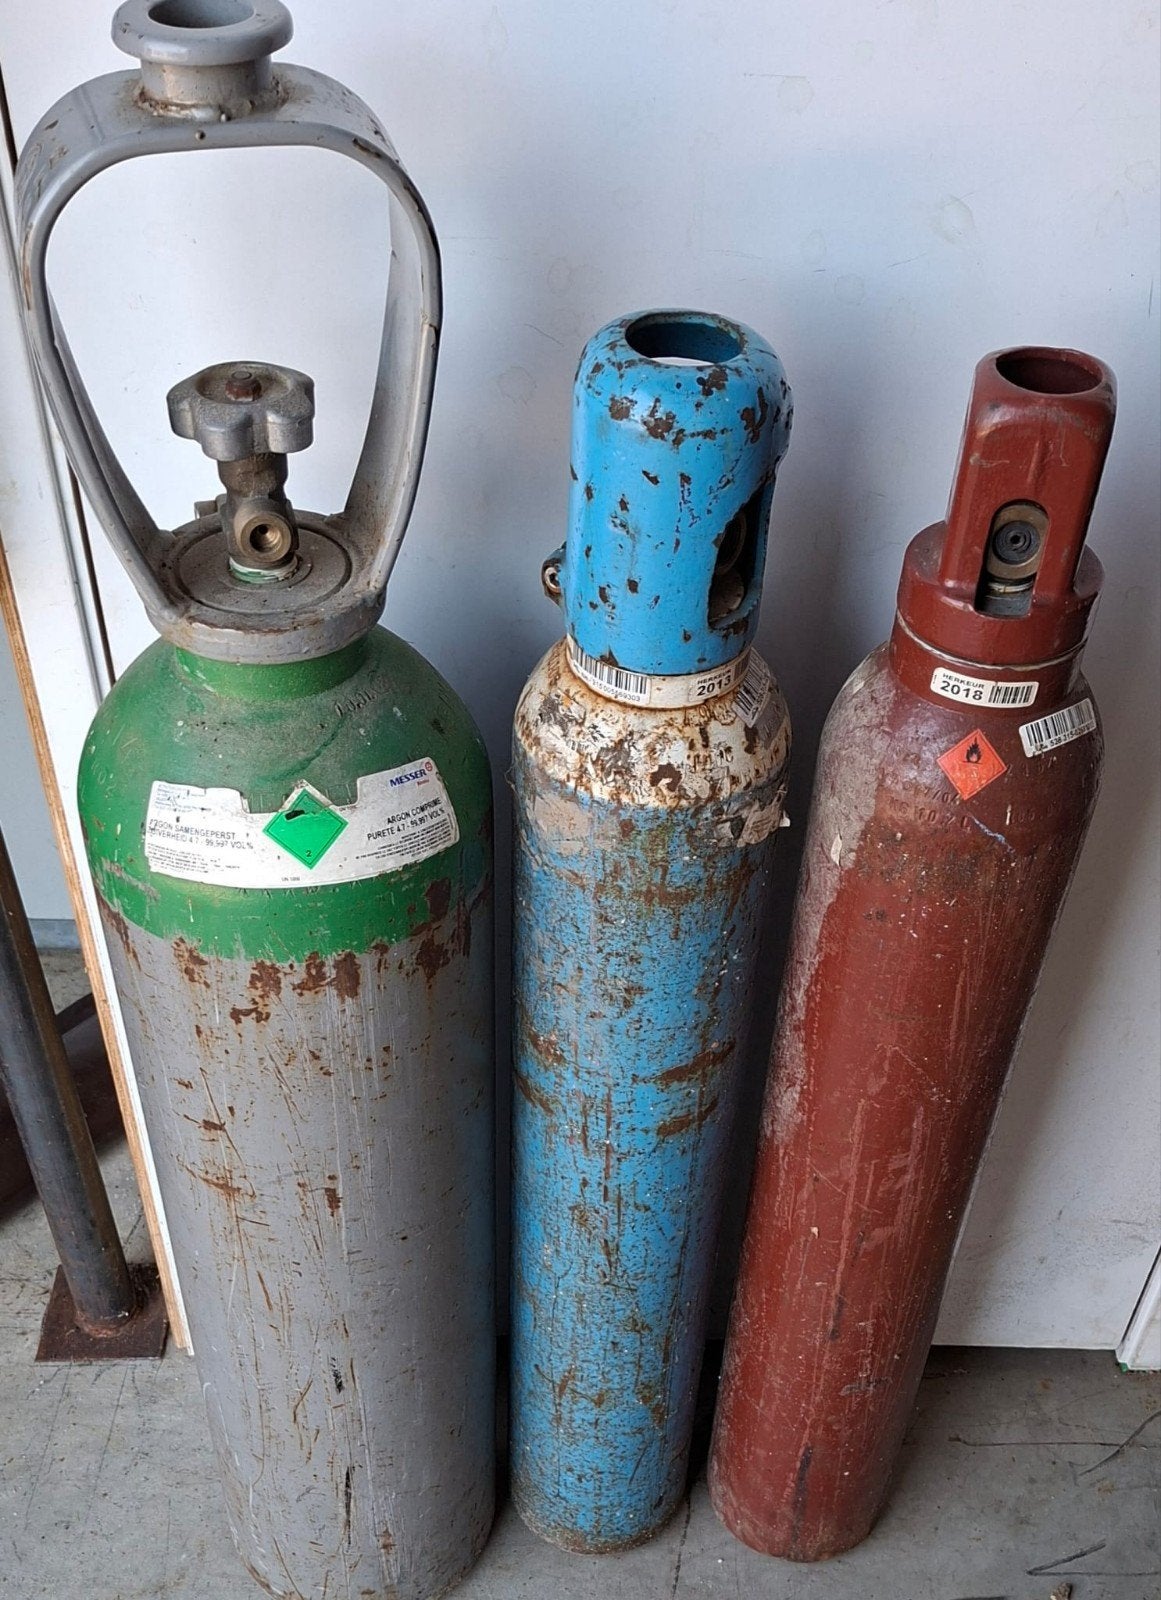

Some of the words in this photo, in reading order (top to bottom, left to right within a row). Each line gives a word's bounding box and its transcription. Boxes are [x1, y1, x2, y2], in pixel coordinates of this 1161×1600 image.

[697, 675, 731, 696] 2013
[943, 673, 985, 689] HERKEUR
[940, 680, 983, 701] 2018
[389, 769, 427, 787] MESSER
[387, 810, 411, 825] ARGON
[175, 824, 236, 840] SAMENGEPERST
[366, 826, 396, 841] PURETE
[306, 849, 312, 857] 2
